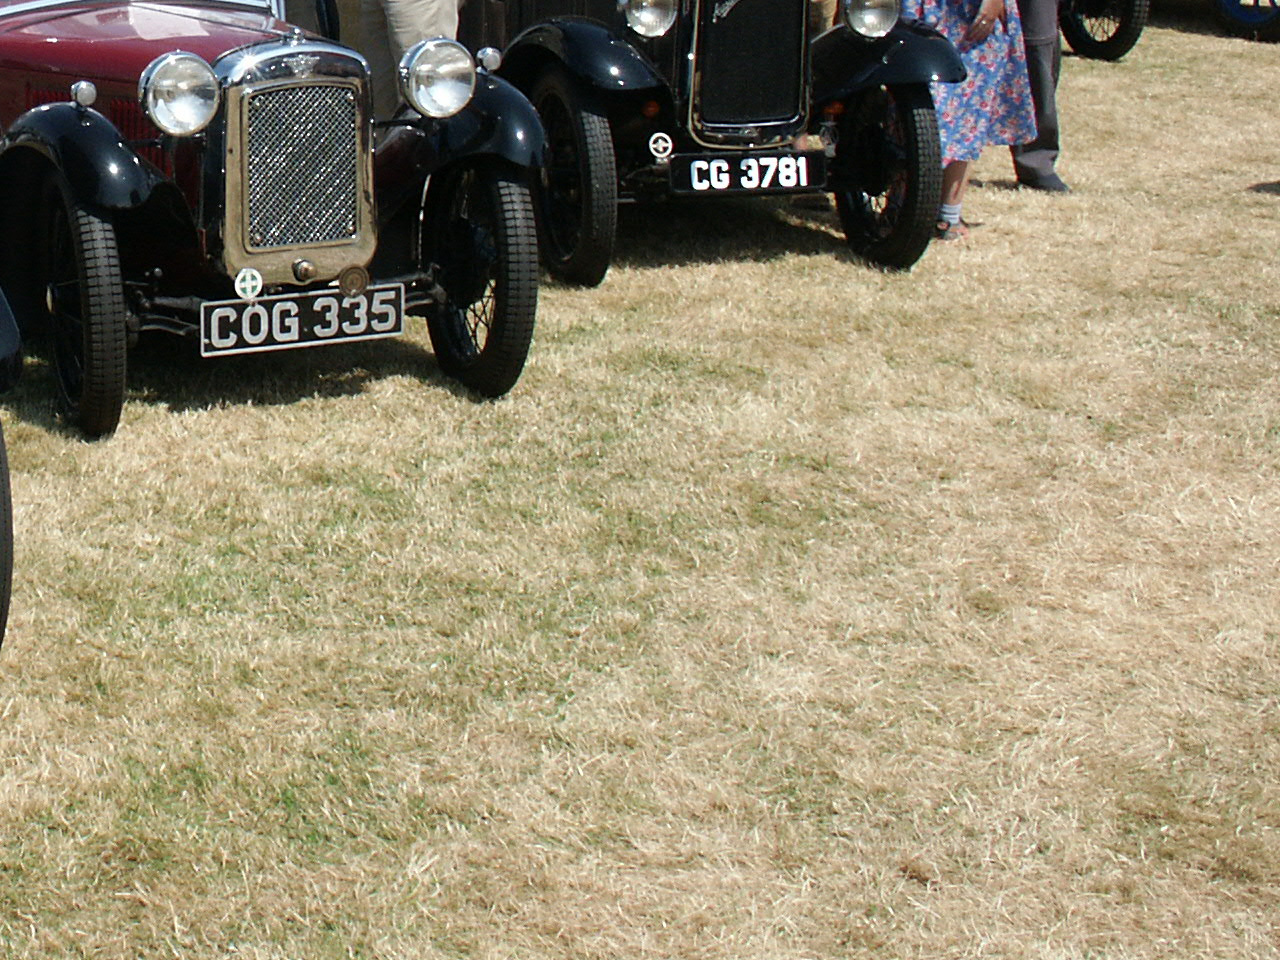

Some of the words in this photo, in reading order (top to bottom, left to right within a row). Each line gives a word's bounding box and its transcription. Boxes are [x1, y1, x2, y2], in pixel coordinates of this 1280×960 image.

[690, 158, 731, 191] CG
[740, 156, 809, 189] 3781
[210, 300, 300, 349] COG
[312, 290, 397, 338] 335
